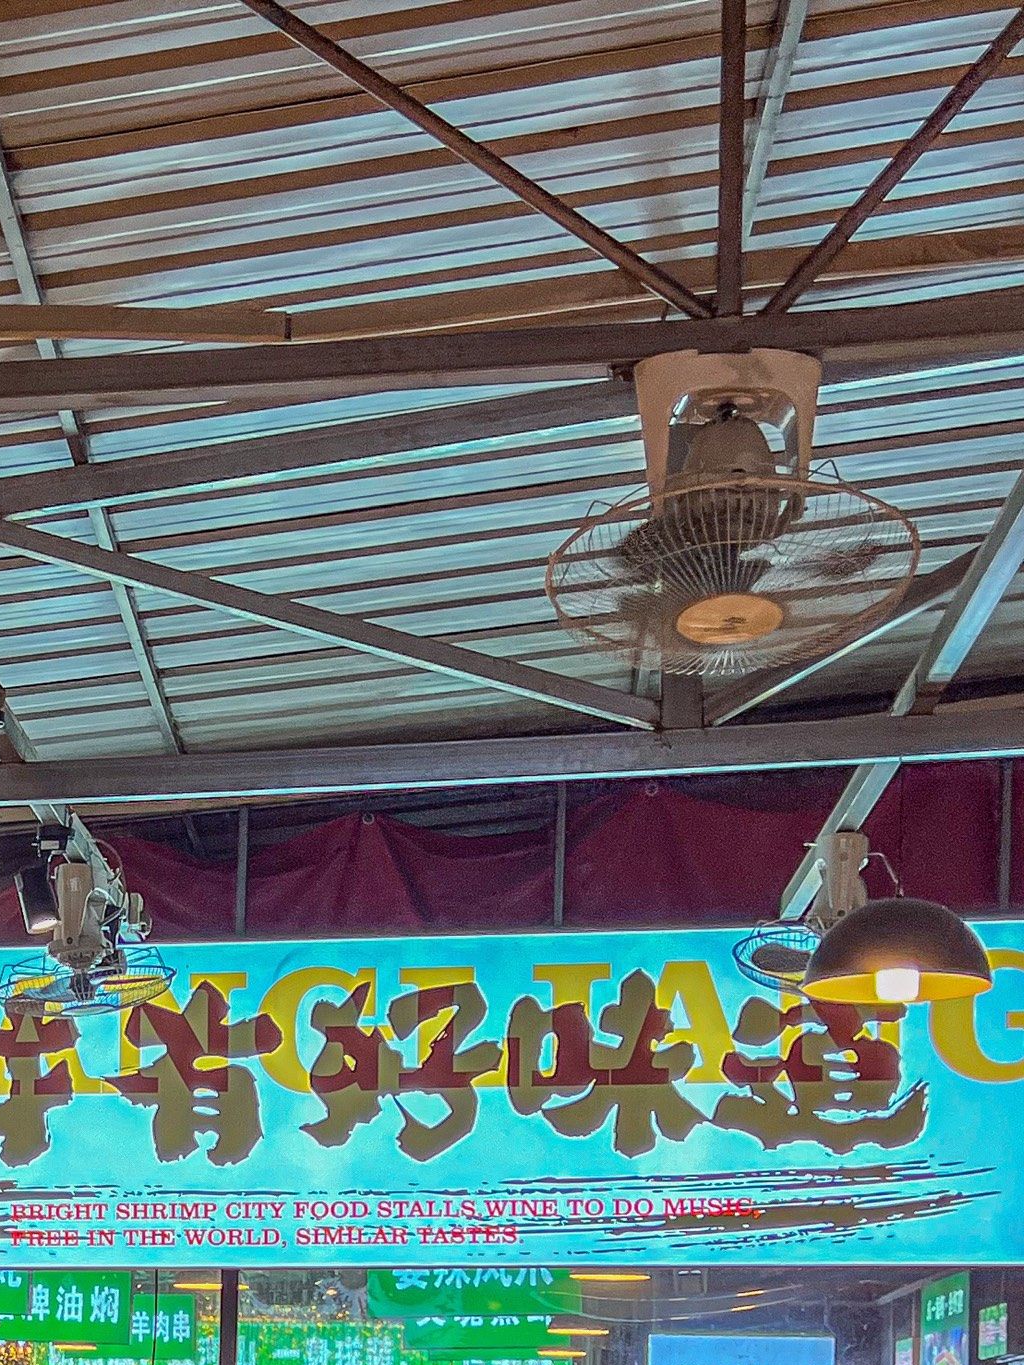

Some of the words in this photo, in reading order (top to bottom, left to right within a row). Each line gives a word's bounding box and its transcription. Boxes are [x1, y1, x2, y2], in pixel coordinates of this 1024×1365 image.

[11, 1202, 108, 1221] BRIGHT
[116, 1202, 218, 1220] SHRIMP
[226, 1201, 285, 1219] CITY
[293, 1201, 369, 1219] FOOD
[567, 1199, 604, 1217] TO
[612, 1198, 654, 1216] DO
[86, 1229, 115, 1247] IN
[125, 1229, 176, 1246] THE
[185, 1228, 288, 1249] WORLD,
[296, 1227, 408, 1246] SIMILAR
